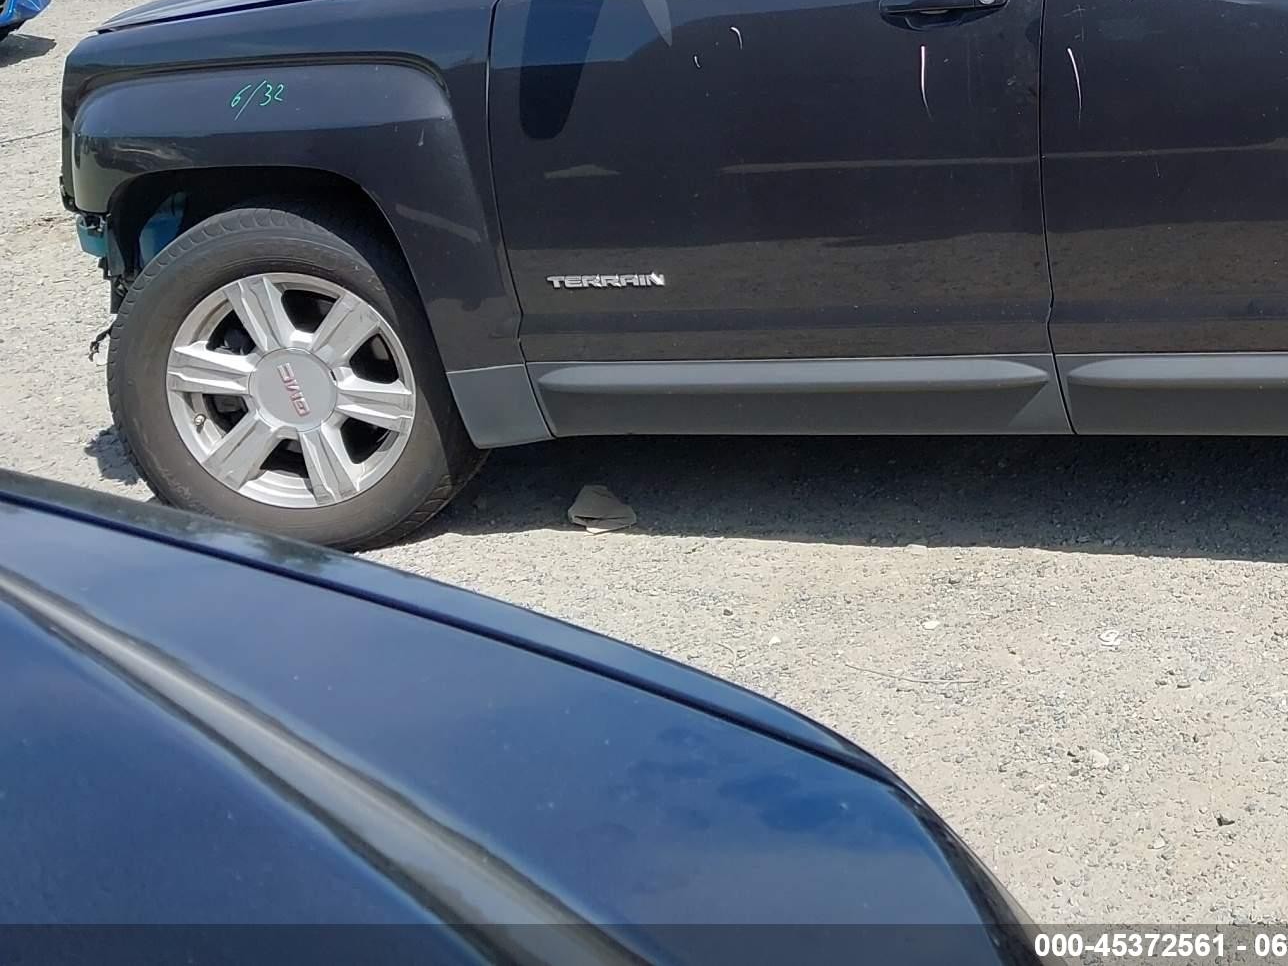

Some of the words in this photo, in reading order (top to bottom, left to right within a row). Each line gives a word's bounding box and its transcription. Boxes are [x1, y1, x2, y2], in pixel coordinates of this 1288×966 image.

[230, 80, 285, 121] 6/32
[546, 272, 666, 289] TERRAIN
[277, 362, 312, 418] GMC
